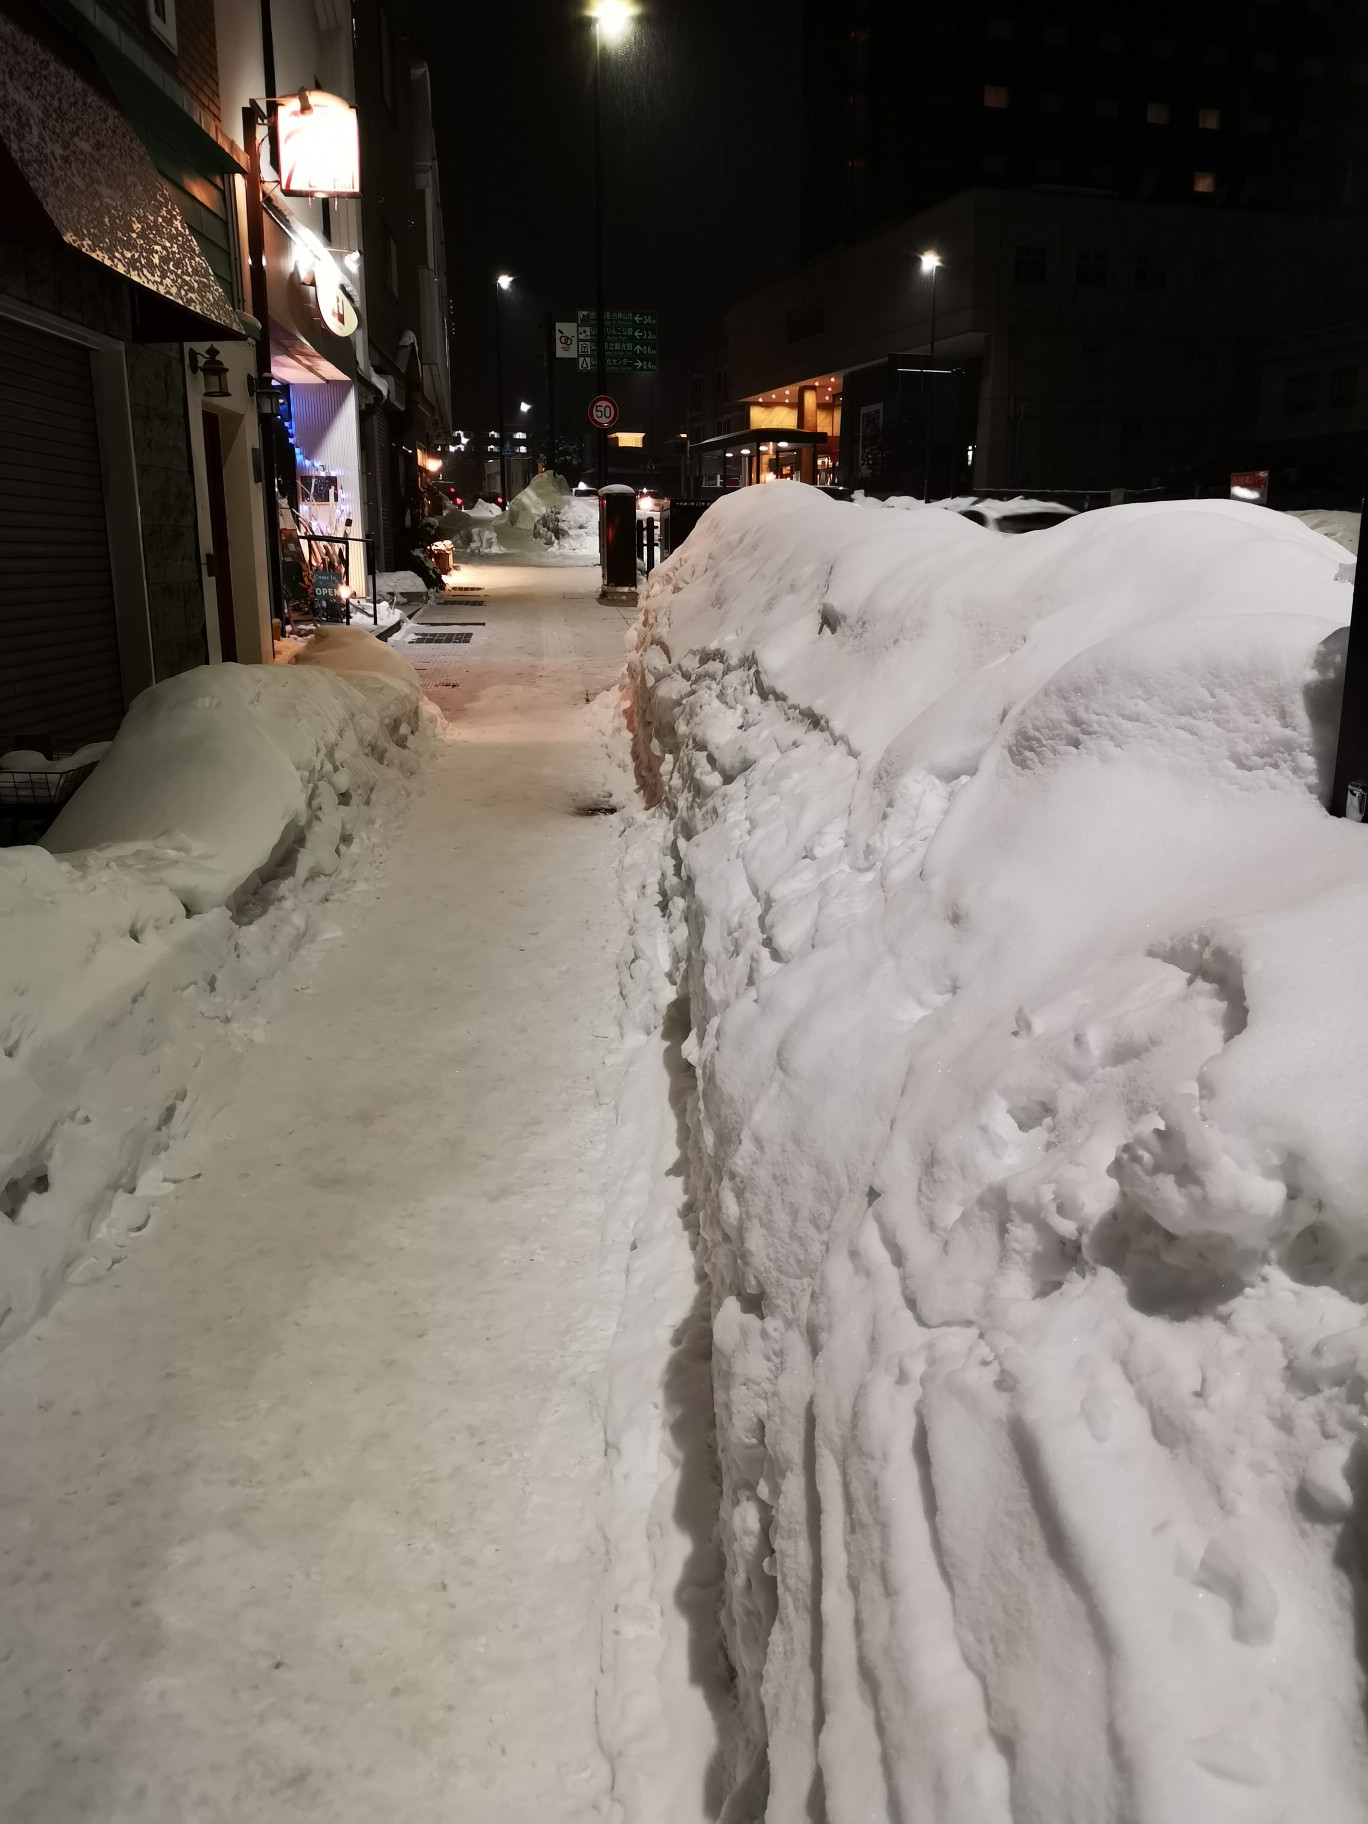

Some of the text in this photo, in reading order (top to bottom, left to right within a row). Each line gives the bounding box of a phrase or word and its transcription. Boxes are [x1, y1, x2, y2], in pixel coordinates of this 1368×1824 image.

[590, 327, 633, 336] 弘りんご公園
[590, 357, 633, 366] 弘化センター
[595, 405, 612, 419] 50
[315, 587, 341, 597] OPEN
